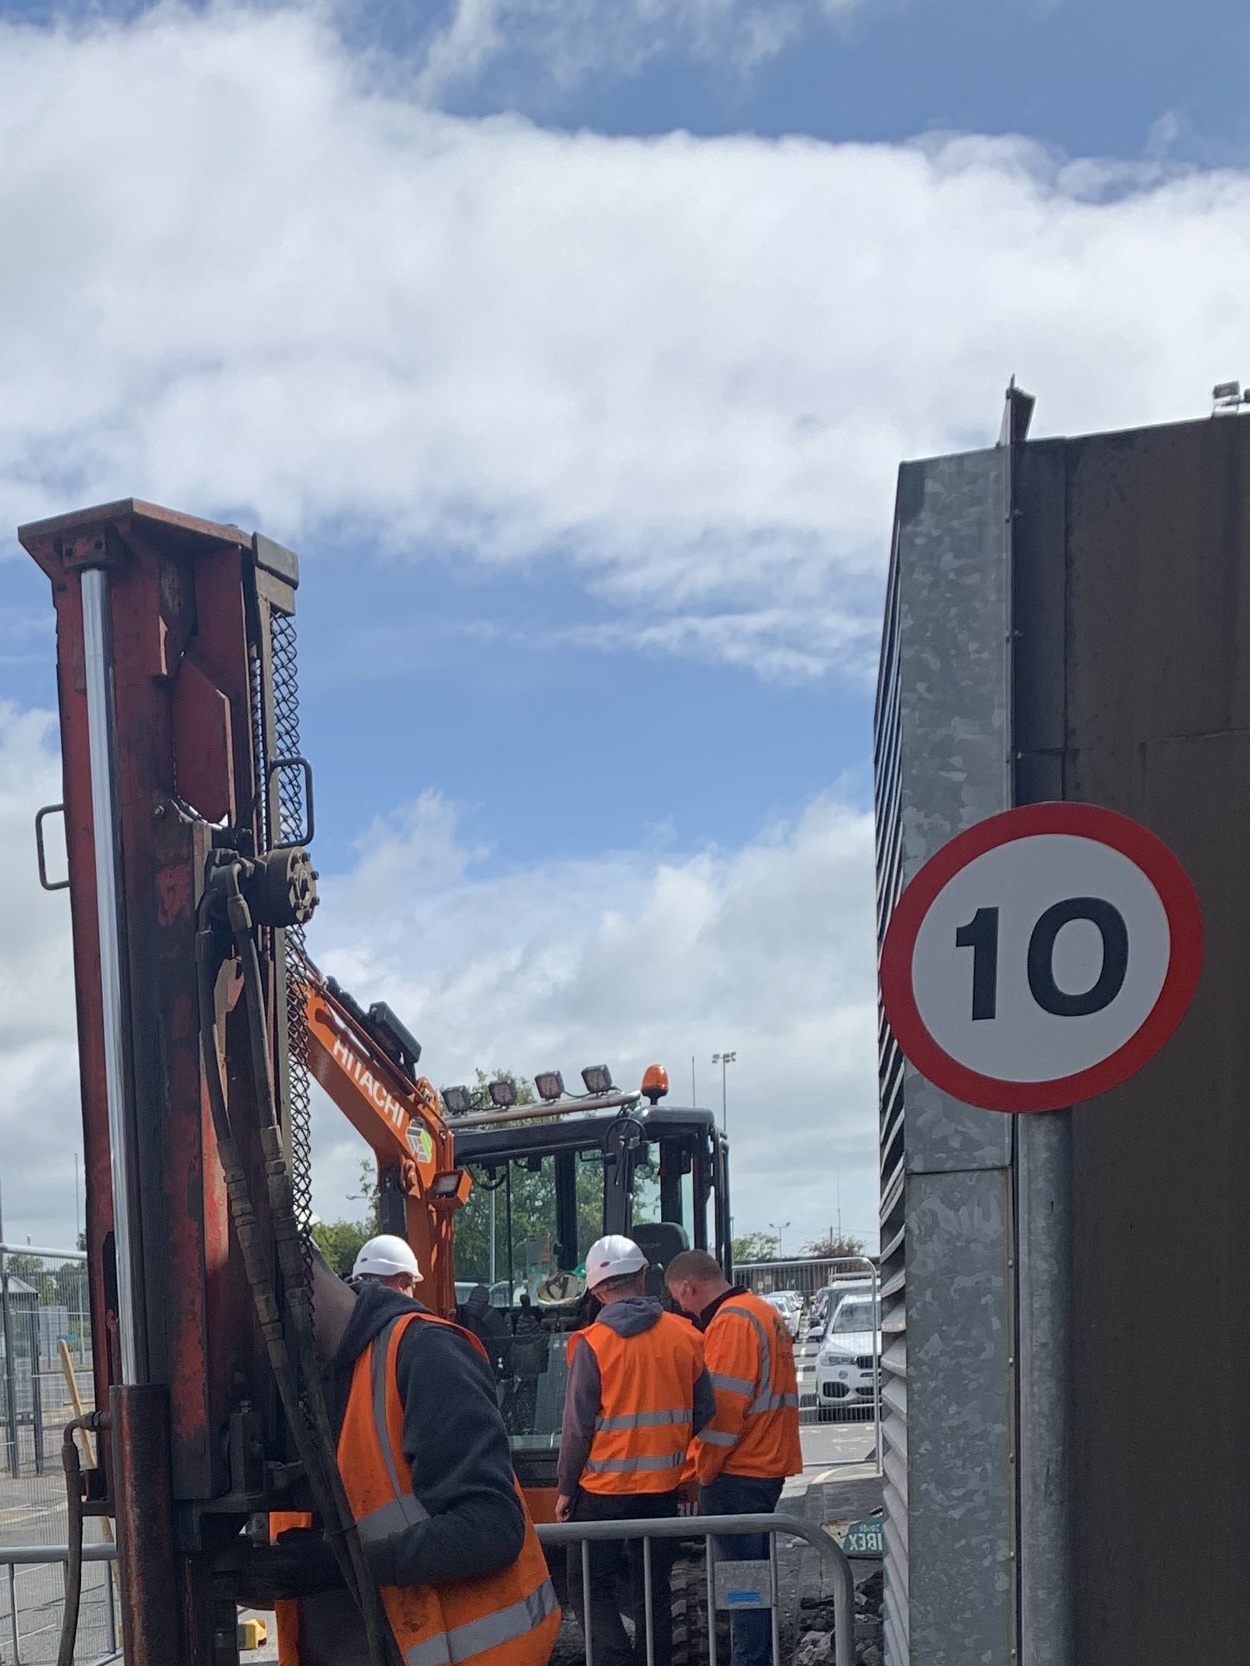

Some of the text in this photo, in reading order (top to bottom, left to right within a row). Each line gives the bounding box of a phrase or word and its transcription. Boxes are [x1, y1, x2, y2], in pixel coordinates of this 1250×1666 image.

[956, 896, 1129, 1020] 10
[333, 1036, 406, 1129] HITACHI
[848, 1532, 883, 1551] IBEX
